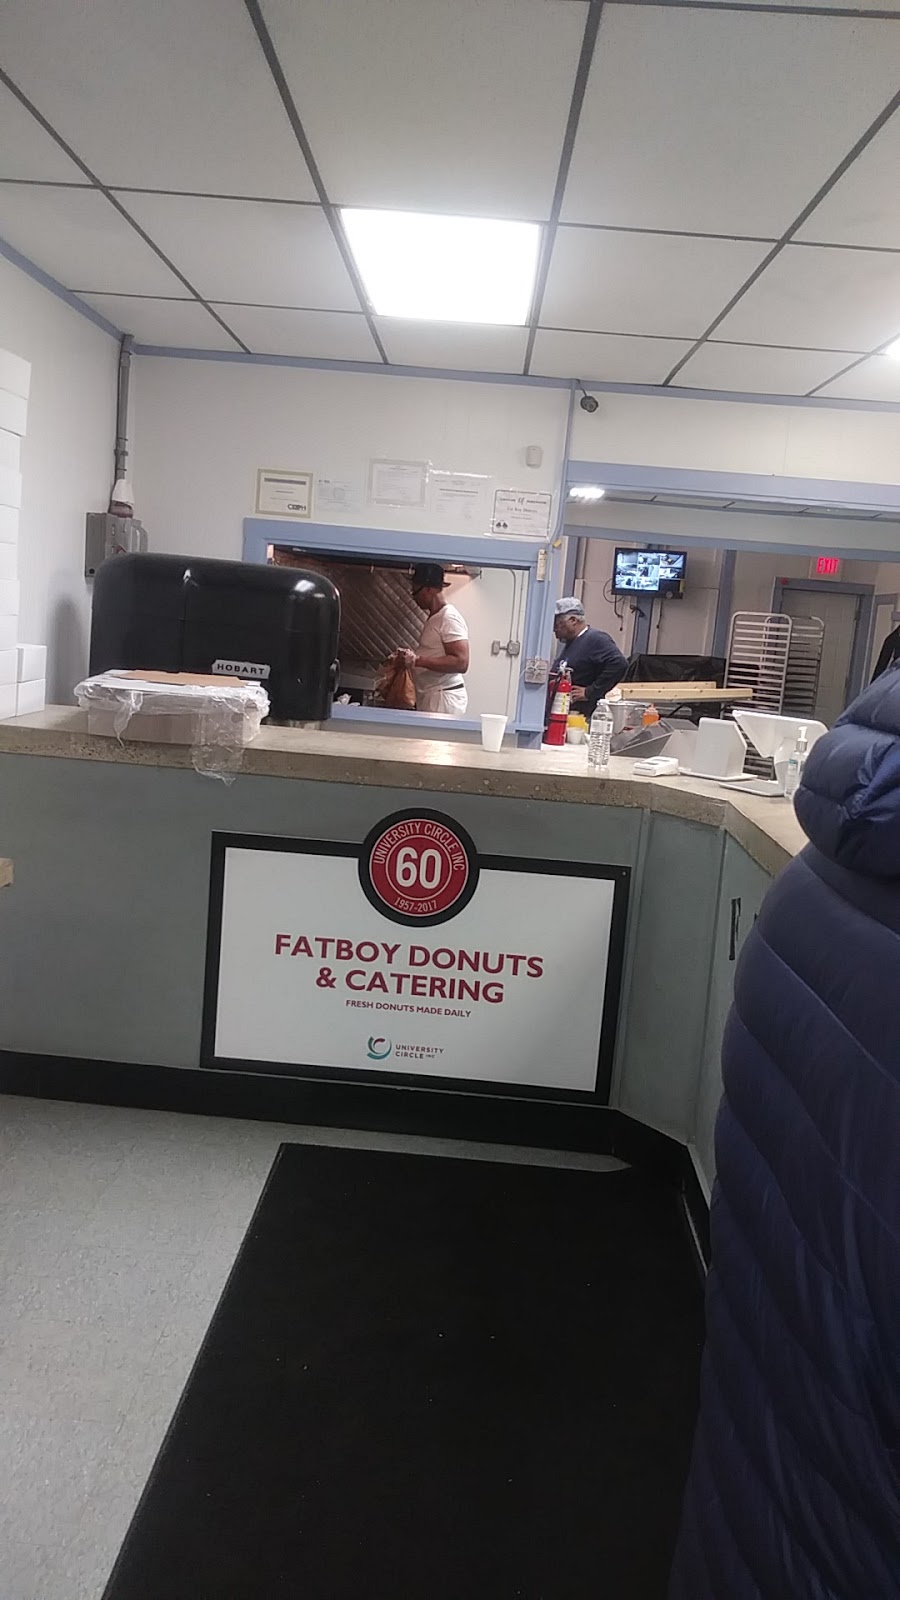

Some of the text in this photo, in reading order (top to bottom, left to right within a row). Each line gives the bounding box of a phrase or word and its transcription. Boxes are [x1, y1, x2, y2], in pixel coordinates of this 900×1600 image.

[817, 557, 839, 574] EXIT
[217, 663, 265, 675] HOBART
[373, 822, 465, 871] UNIVERSITY CIRCLE INC
[396, 846, 442, 890] 60
[394, 897, 438, 913] 1957-2017
[275, 934, 543, 978] FATBOY DONUTS
[316, 967, 504, 1003] & CATERING
[346, 999, 472, 1018] FRESH DONUTS MADE DAILY
[395, 1044, 444, 1053] UNIVERSITY
[395, 1051, 424, 1059] CIRCLE
